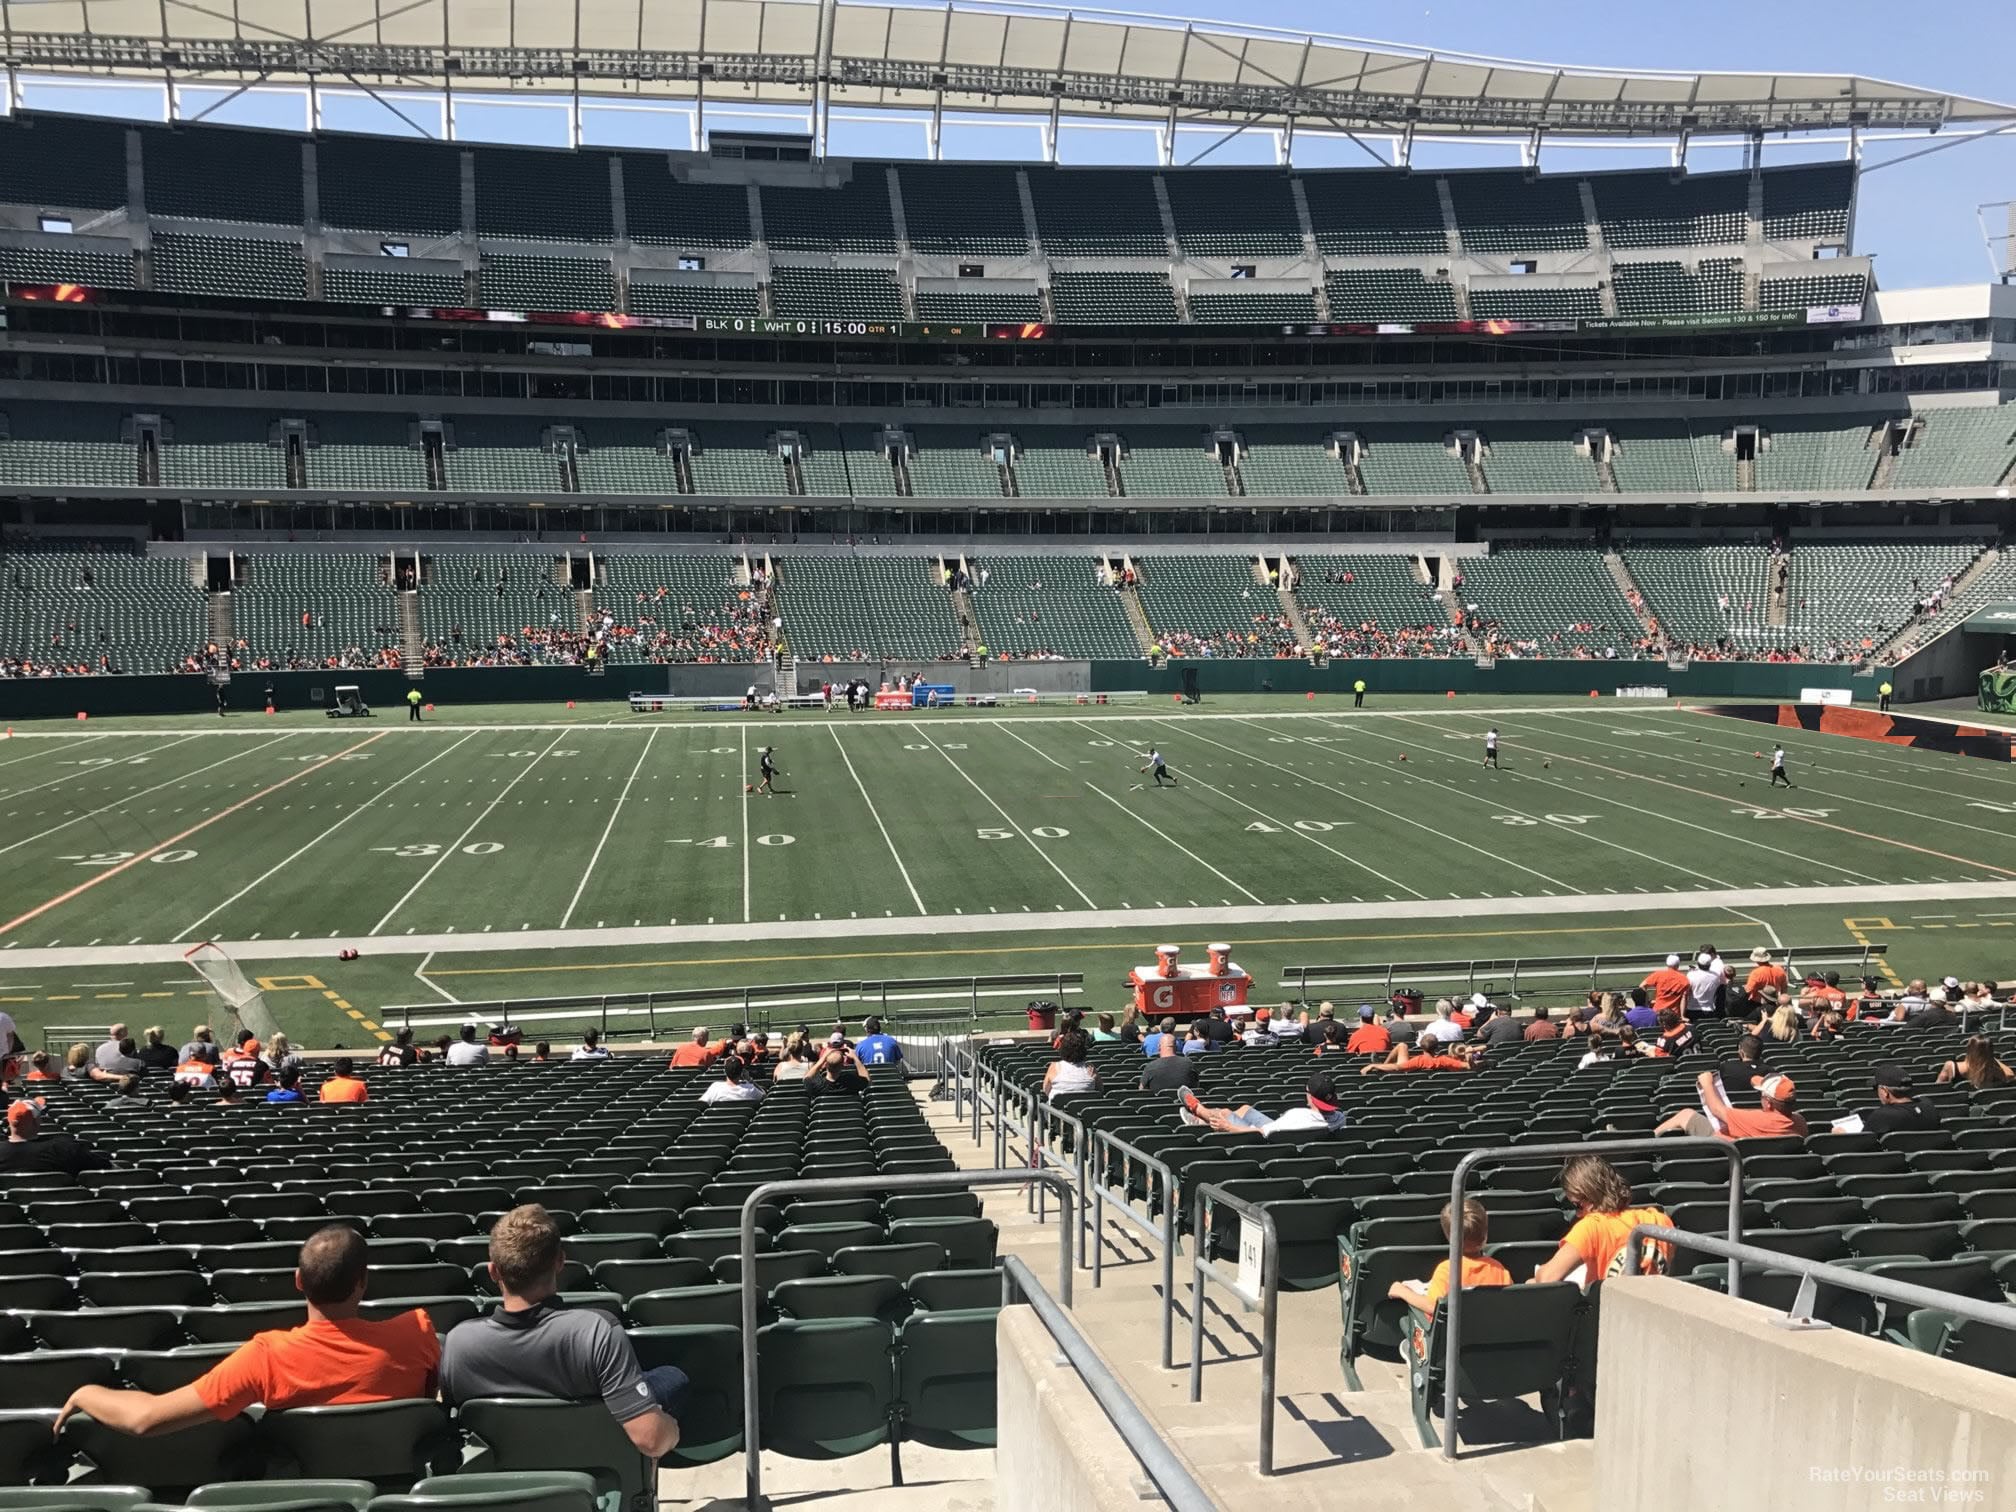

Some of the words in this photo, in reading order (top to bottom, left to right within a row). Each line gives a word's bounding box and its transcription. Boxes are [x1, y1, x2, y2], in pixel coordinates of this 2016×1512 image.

[705, 319, 728, 330] BLK
[734, 319, 744, 331] 0
[764, 321, 791, 332] WHT
[796, 321, 806, 333] 0
[824, 322, 866, 334] 15:00
[890, 325, 896, 334] 1
[1609, 320, 1640, 328] Available
[1491, 814, 1587, 825] 30
[1244, 820, 1333, 832] 40
[976, 826, 1070, 839] 50
[696, 834, 796, 848] 40
[395, 842, 505, 857] 30
[73, 850, 199, 866] 20
[1153, 985, 1174, 1008] G
